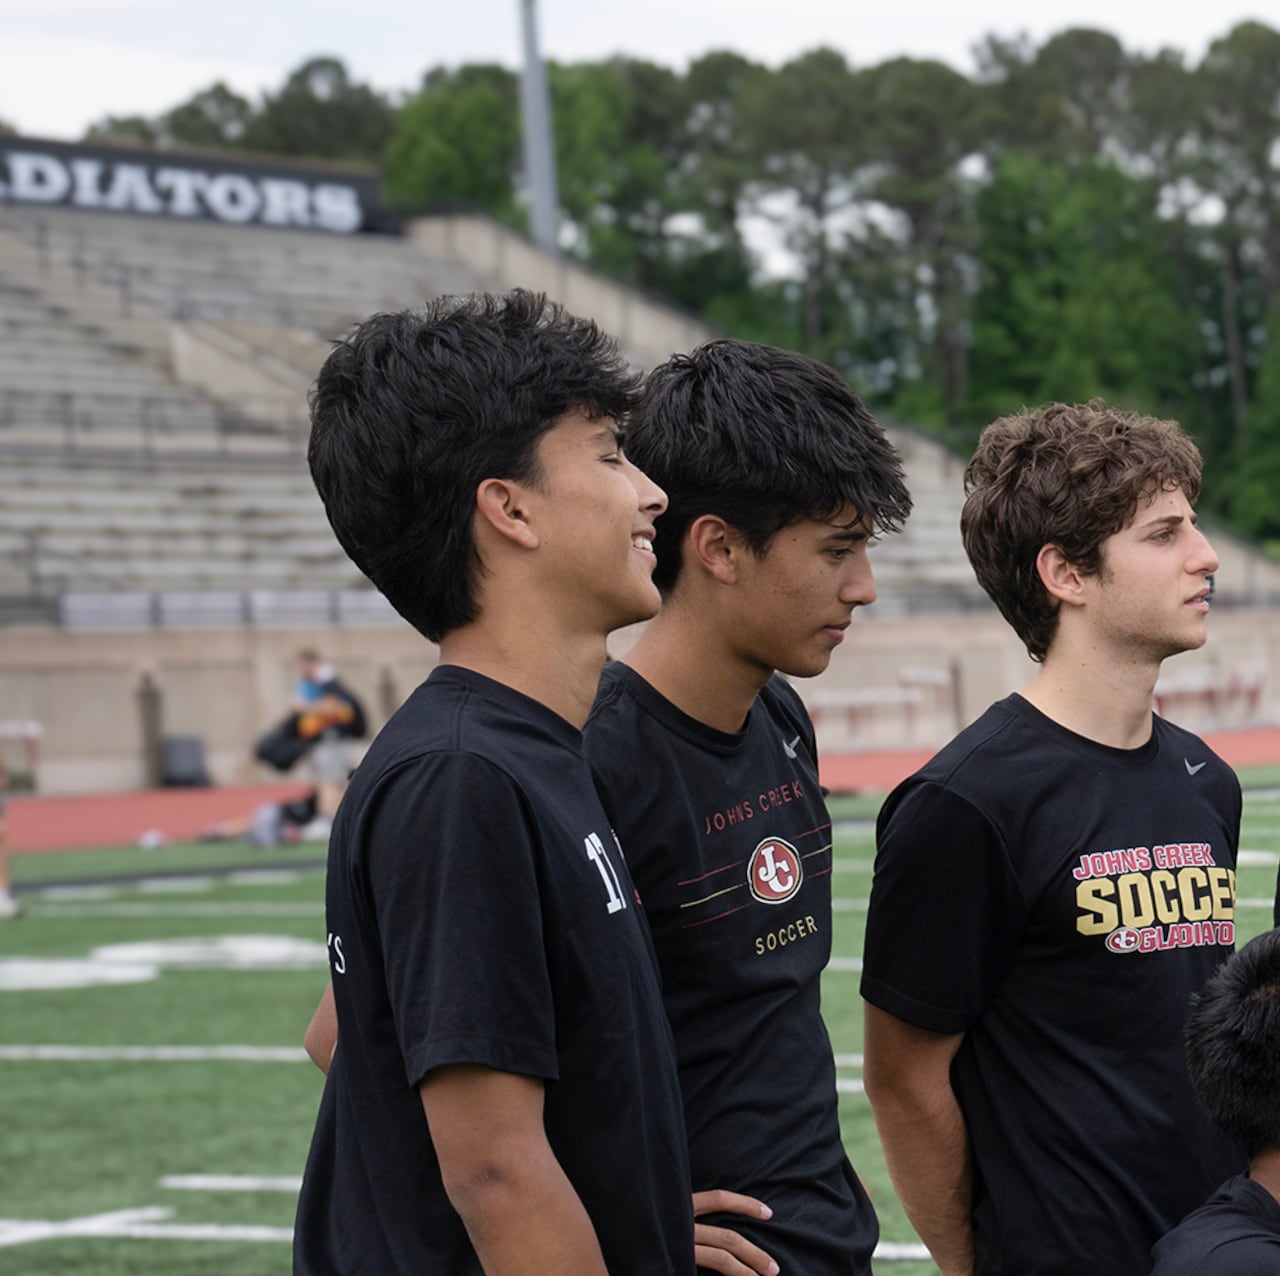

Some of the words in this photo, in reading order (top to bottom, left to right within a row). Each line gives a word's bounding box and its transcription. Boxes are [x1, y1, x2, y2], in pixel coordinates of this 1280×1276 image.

[0, 152, 363, 232] DIATORS
[705, 800, 754, 835] JOHNS
[758, 780, 803, 812] CREEK
[758, 846, 794, 893] JC
[1073, 847, 1151, 880] JOHNS
[1153, 843, 1216, 868] CREEK
[755, 915, 818, 956] SOCCER
